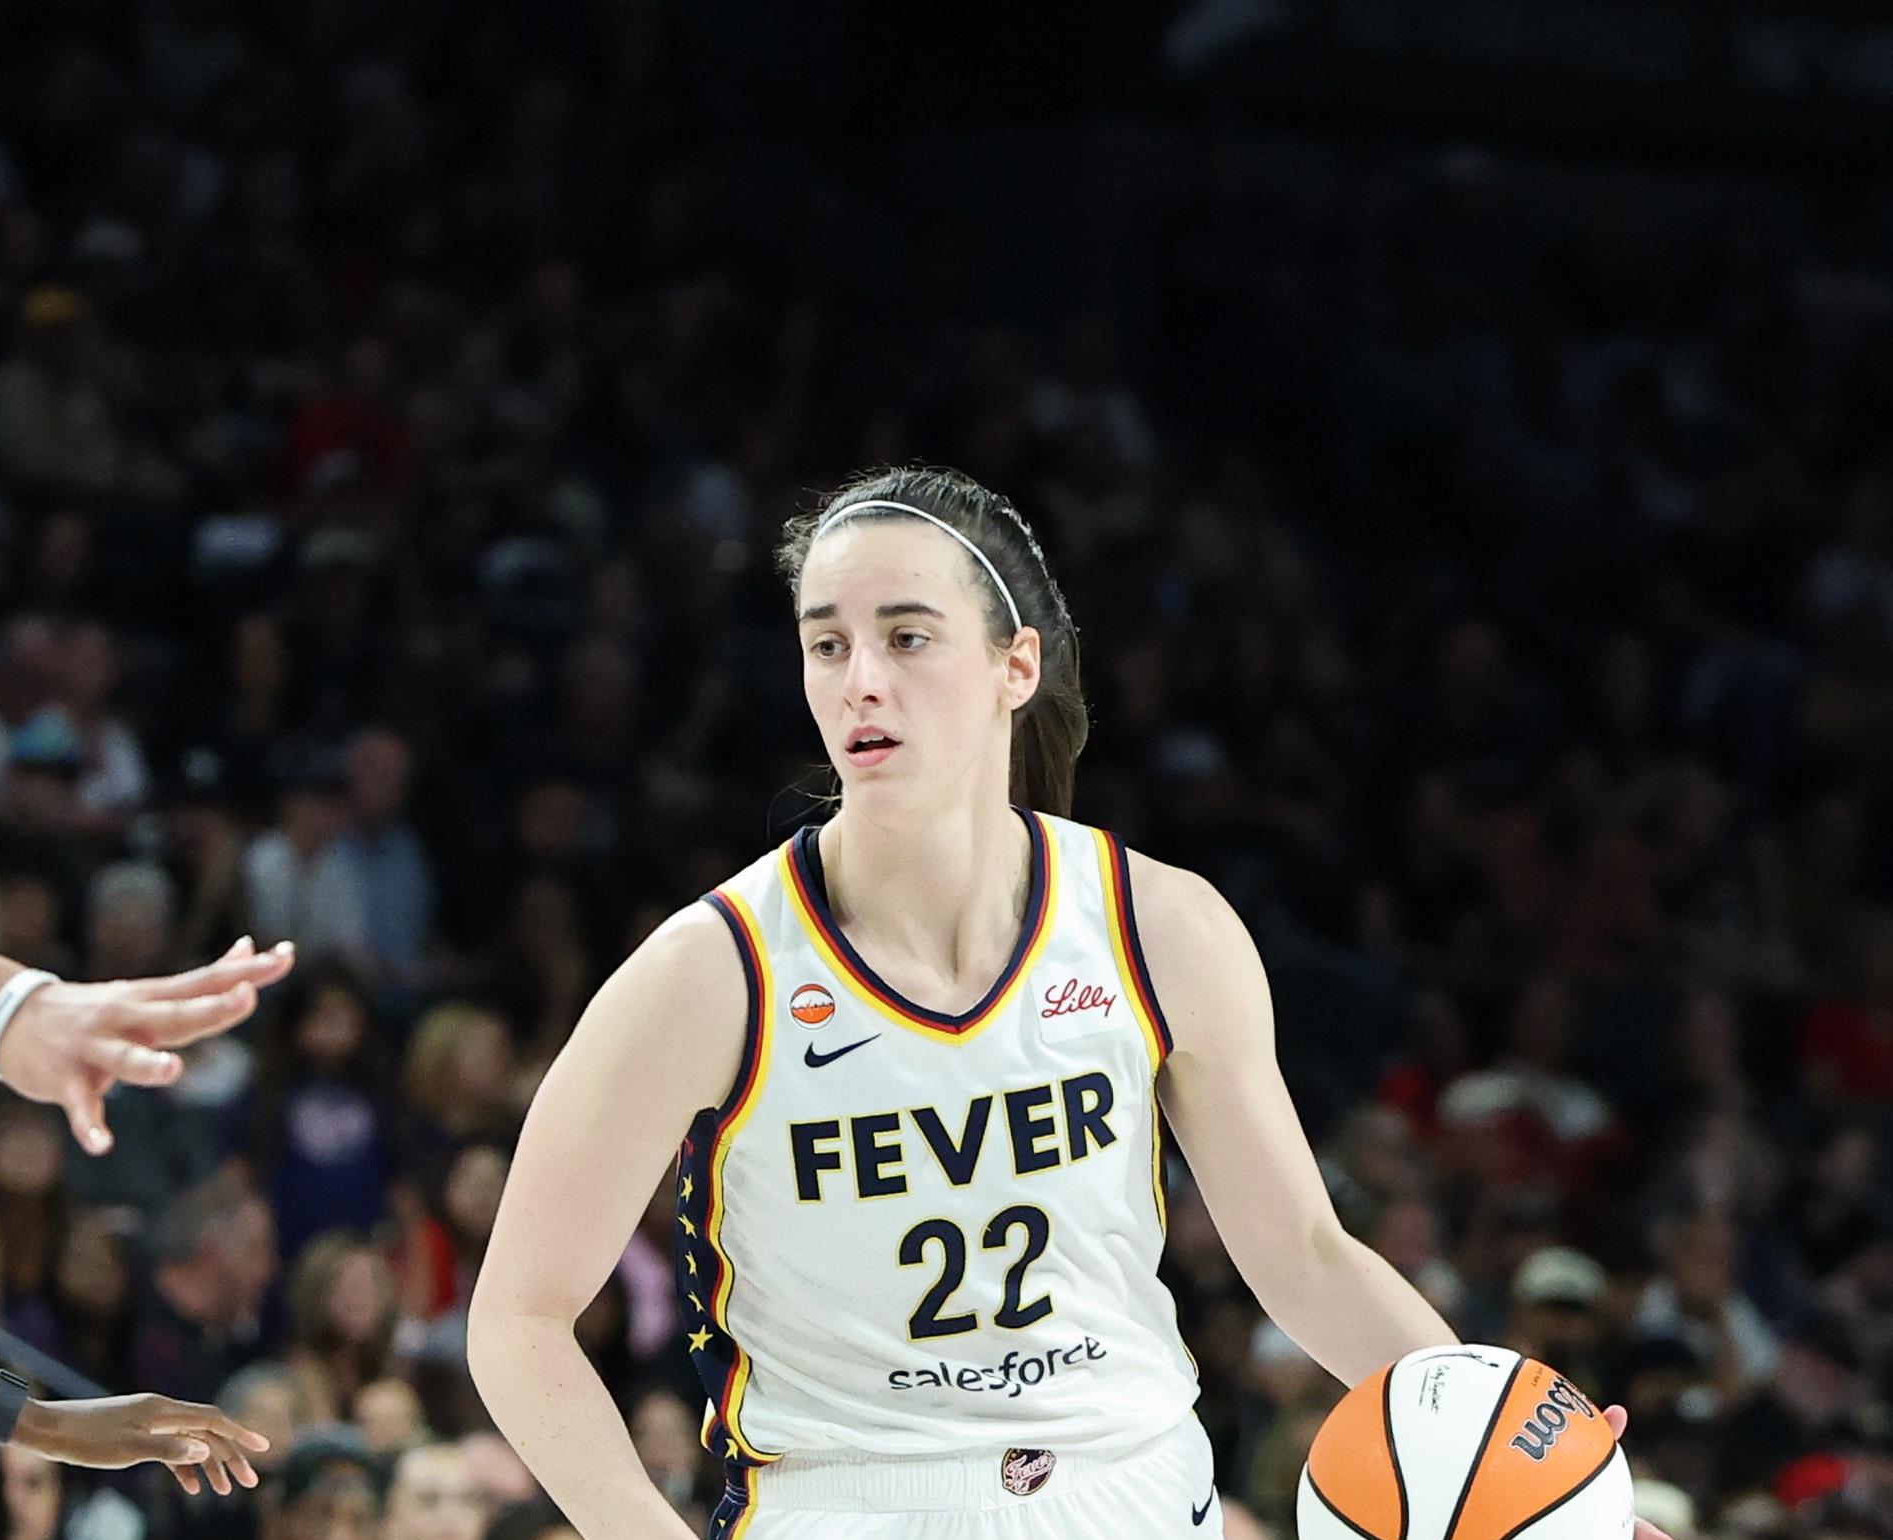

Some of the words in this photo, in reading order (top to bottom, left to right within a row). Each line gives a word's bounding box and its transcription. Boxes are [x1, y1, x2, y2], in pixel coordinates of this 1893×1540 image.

[1041, 978, 1117, 1018] Lilly
[788, 1070, 1119, 1203] FEVER
[897, 1203, 1055, 1342] 22
[888, 1336, 1107, 1398] salesforce
